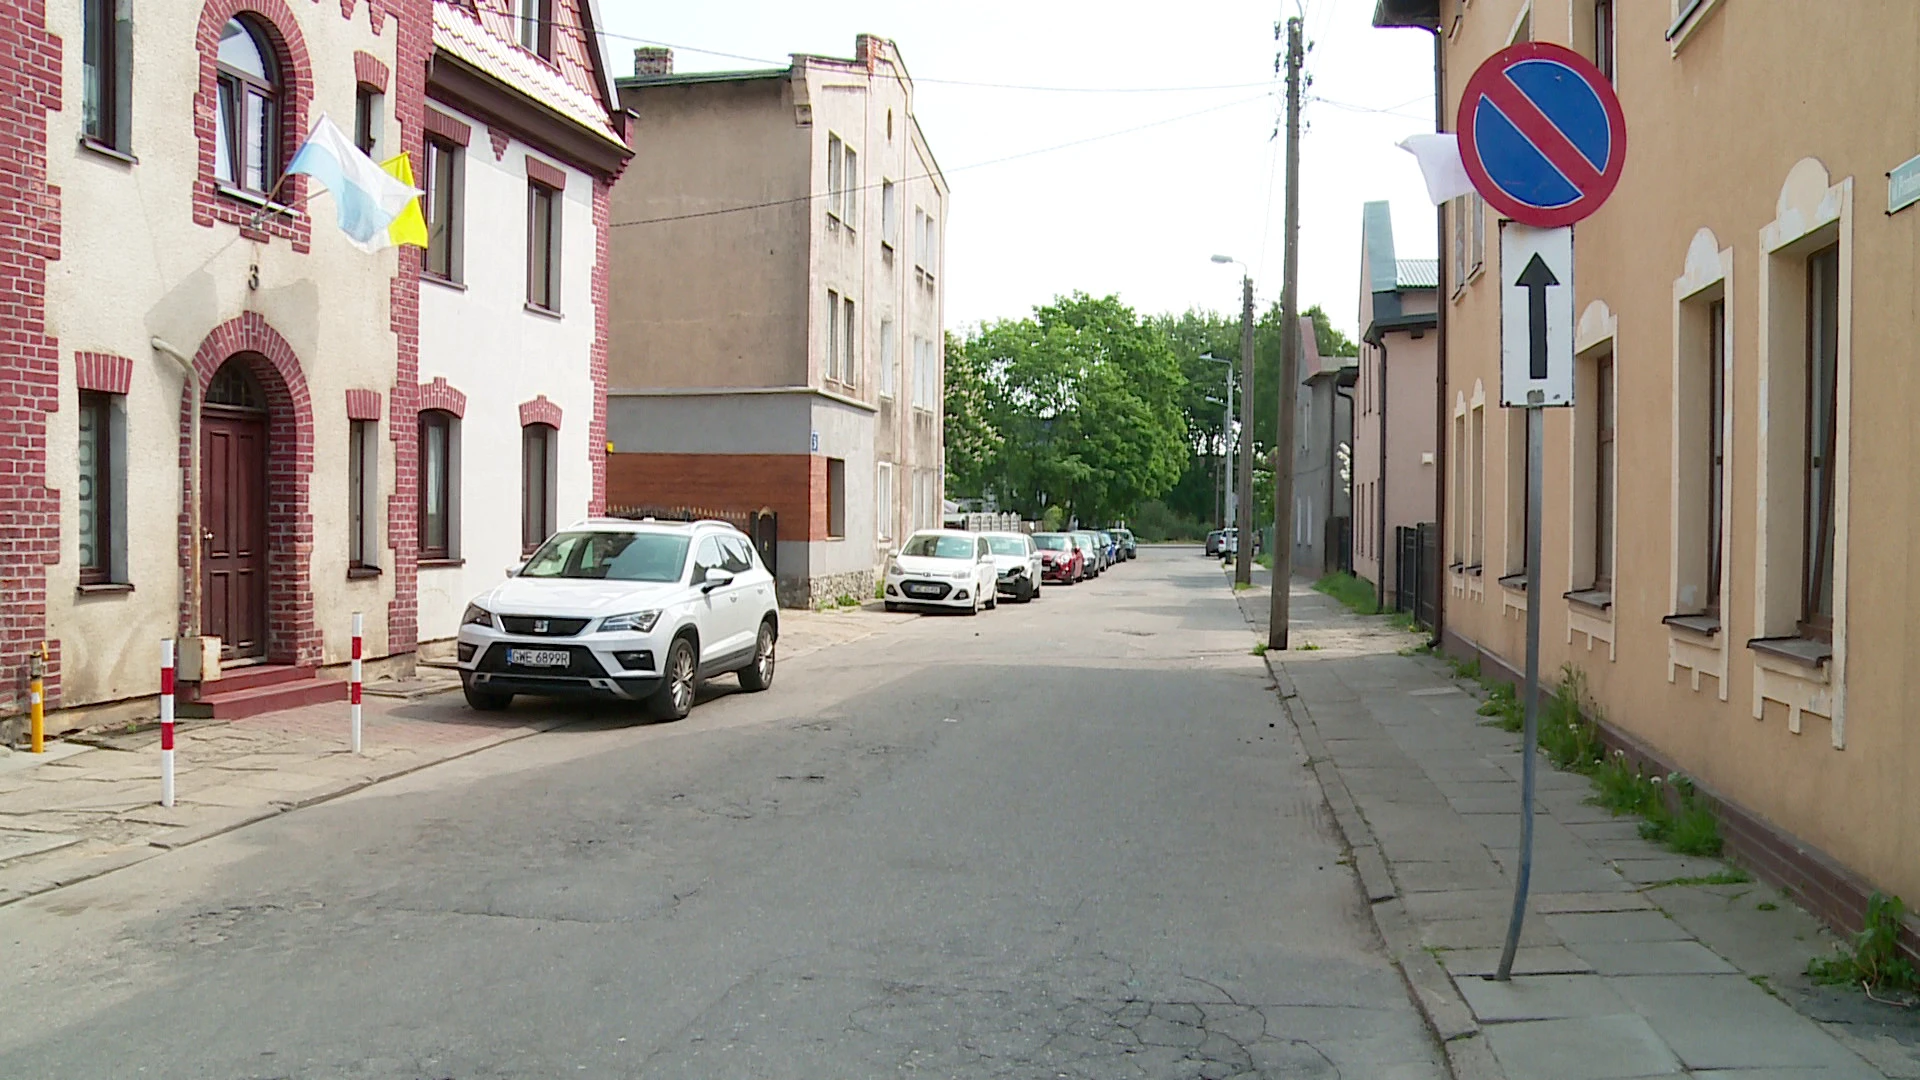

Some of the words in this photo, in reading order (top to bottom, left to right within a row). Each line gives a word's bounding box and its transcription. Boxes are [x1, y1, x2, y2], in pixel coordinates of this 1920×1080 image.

[248, 263, 259, 291] 3
[512, 650, 533, 663] GWE
[535, 651, 568, 665] 6899R
